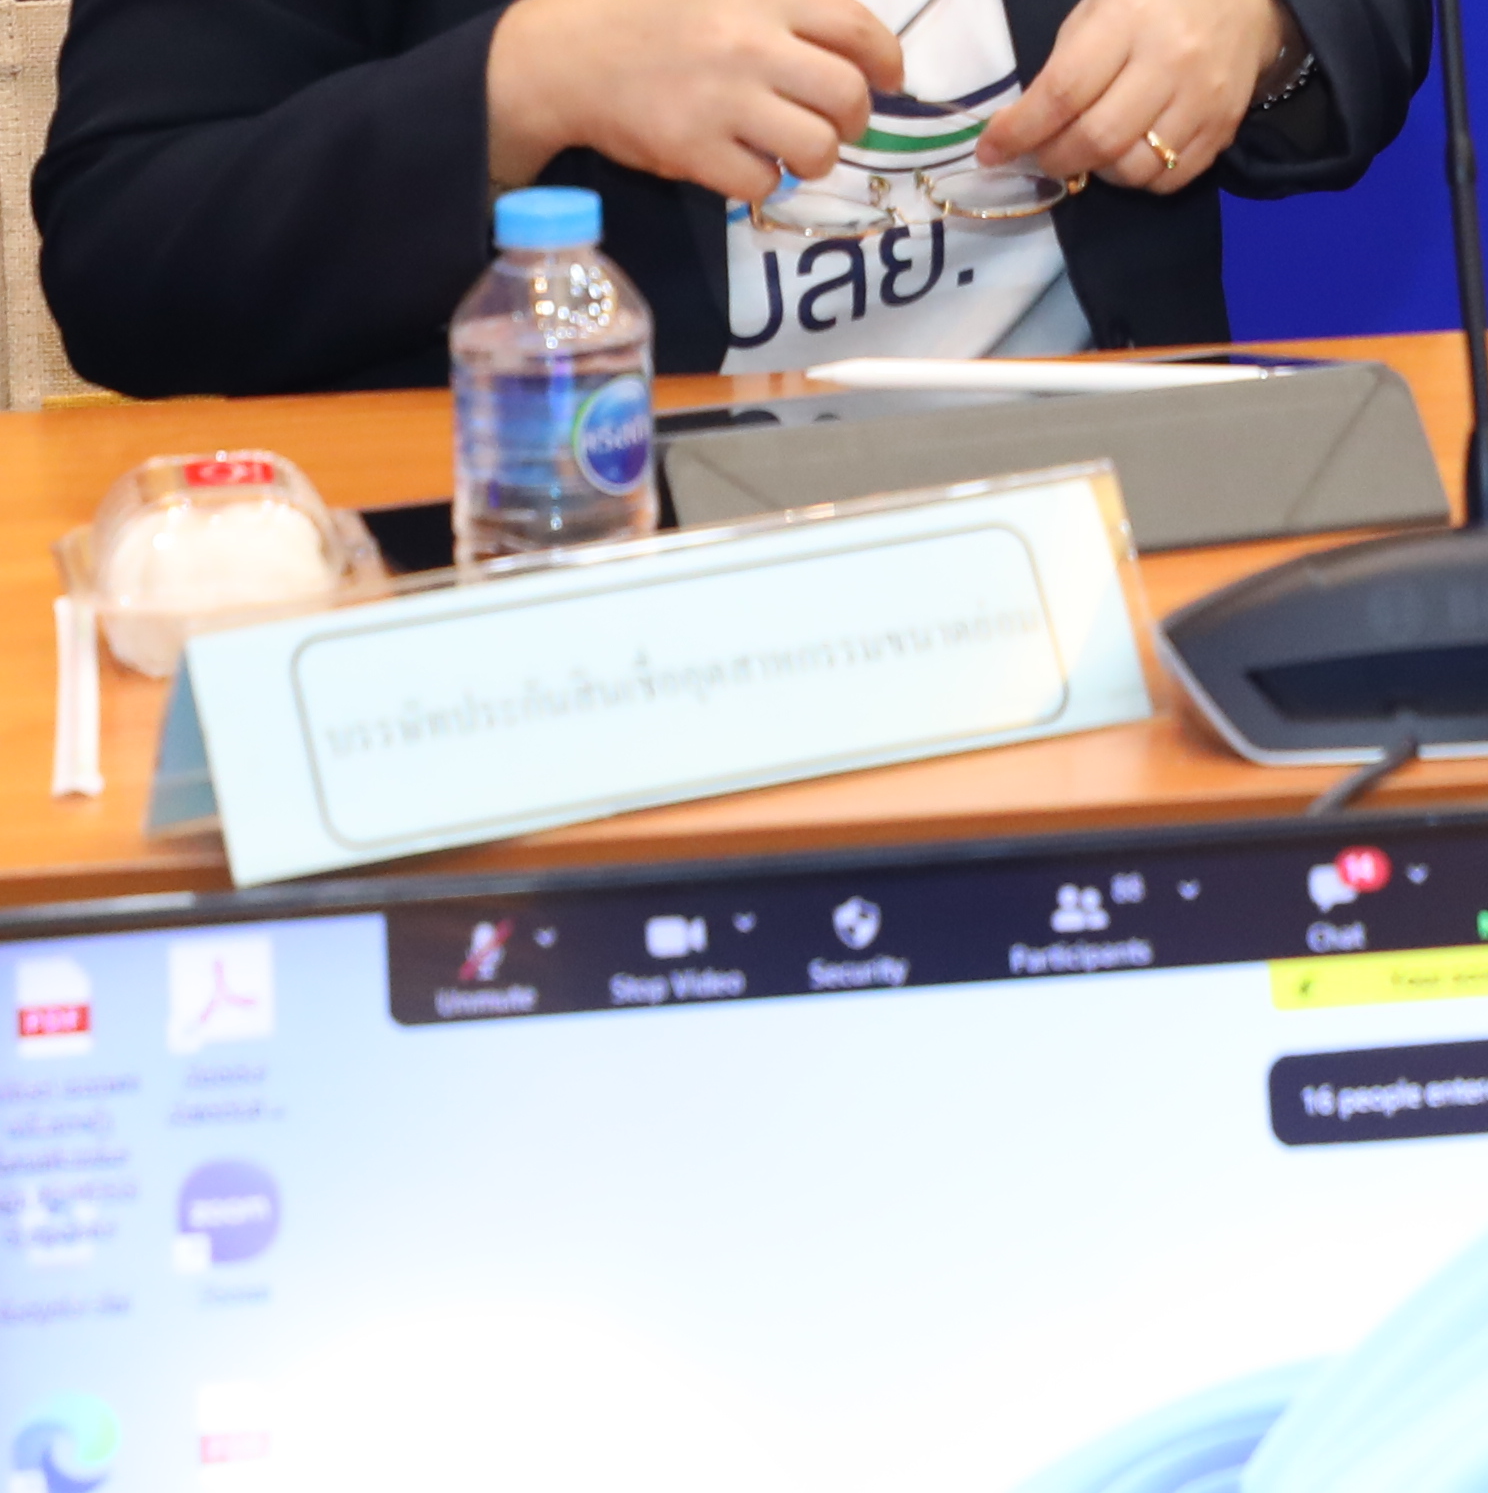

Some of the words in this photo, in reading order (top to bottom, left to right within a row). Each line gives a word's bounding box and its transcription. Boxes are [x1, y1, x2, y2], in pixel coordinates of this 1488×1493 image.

[1009, 936, 1154, 974] Participants
[1305, 920, 1367, 954] Chat
[609, 972, 669, 1005] Stop
[670, 967, 746, 1000] Video
[808, 955, 909, 990] Security
[434, 983, 538, 1018] Unmute
[1302, 1084, 1335, 1116] 16
[1337, 1079, 1422, 1120] people
